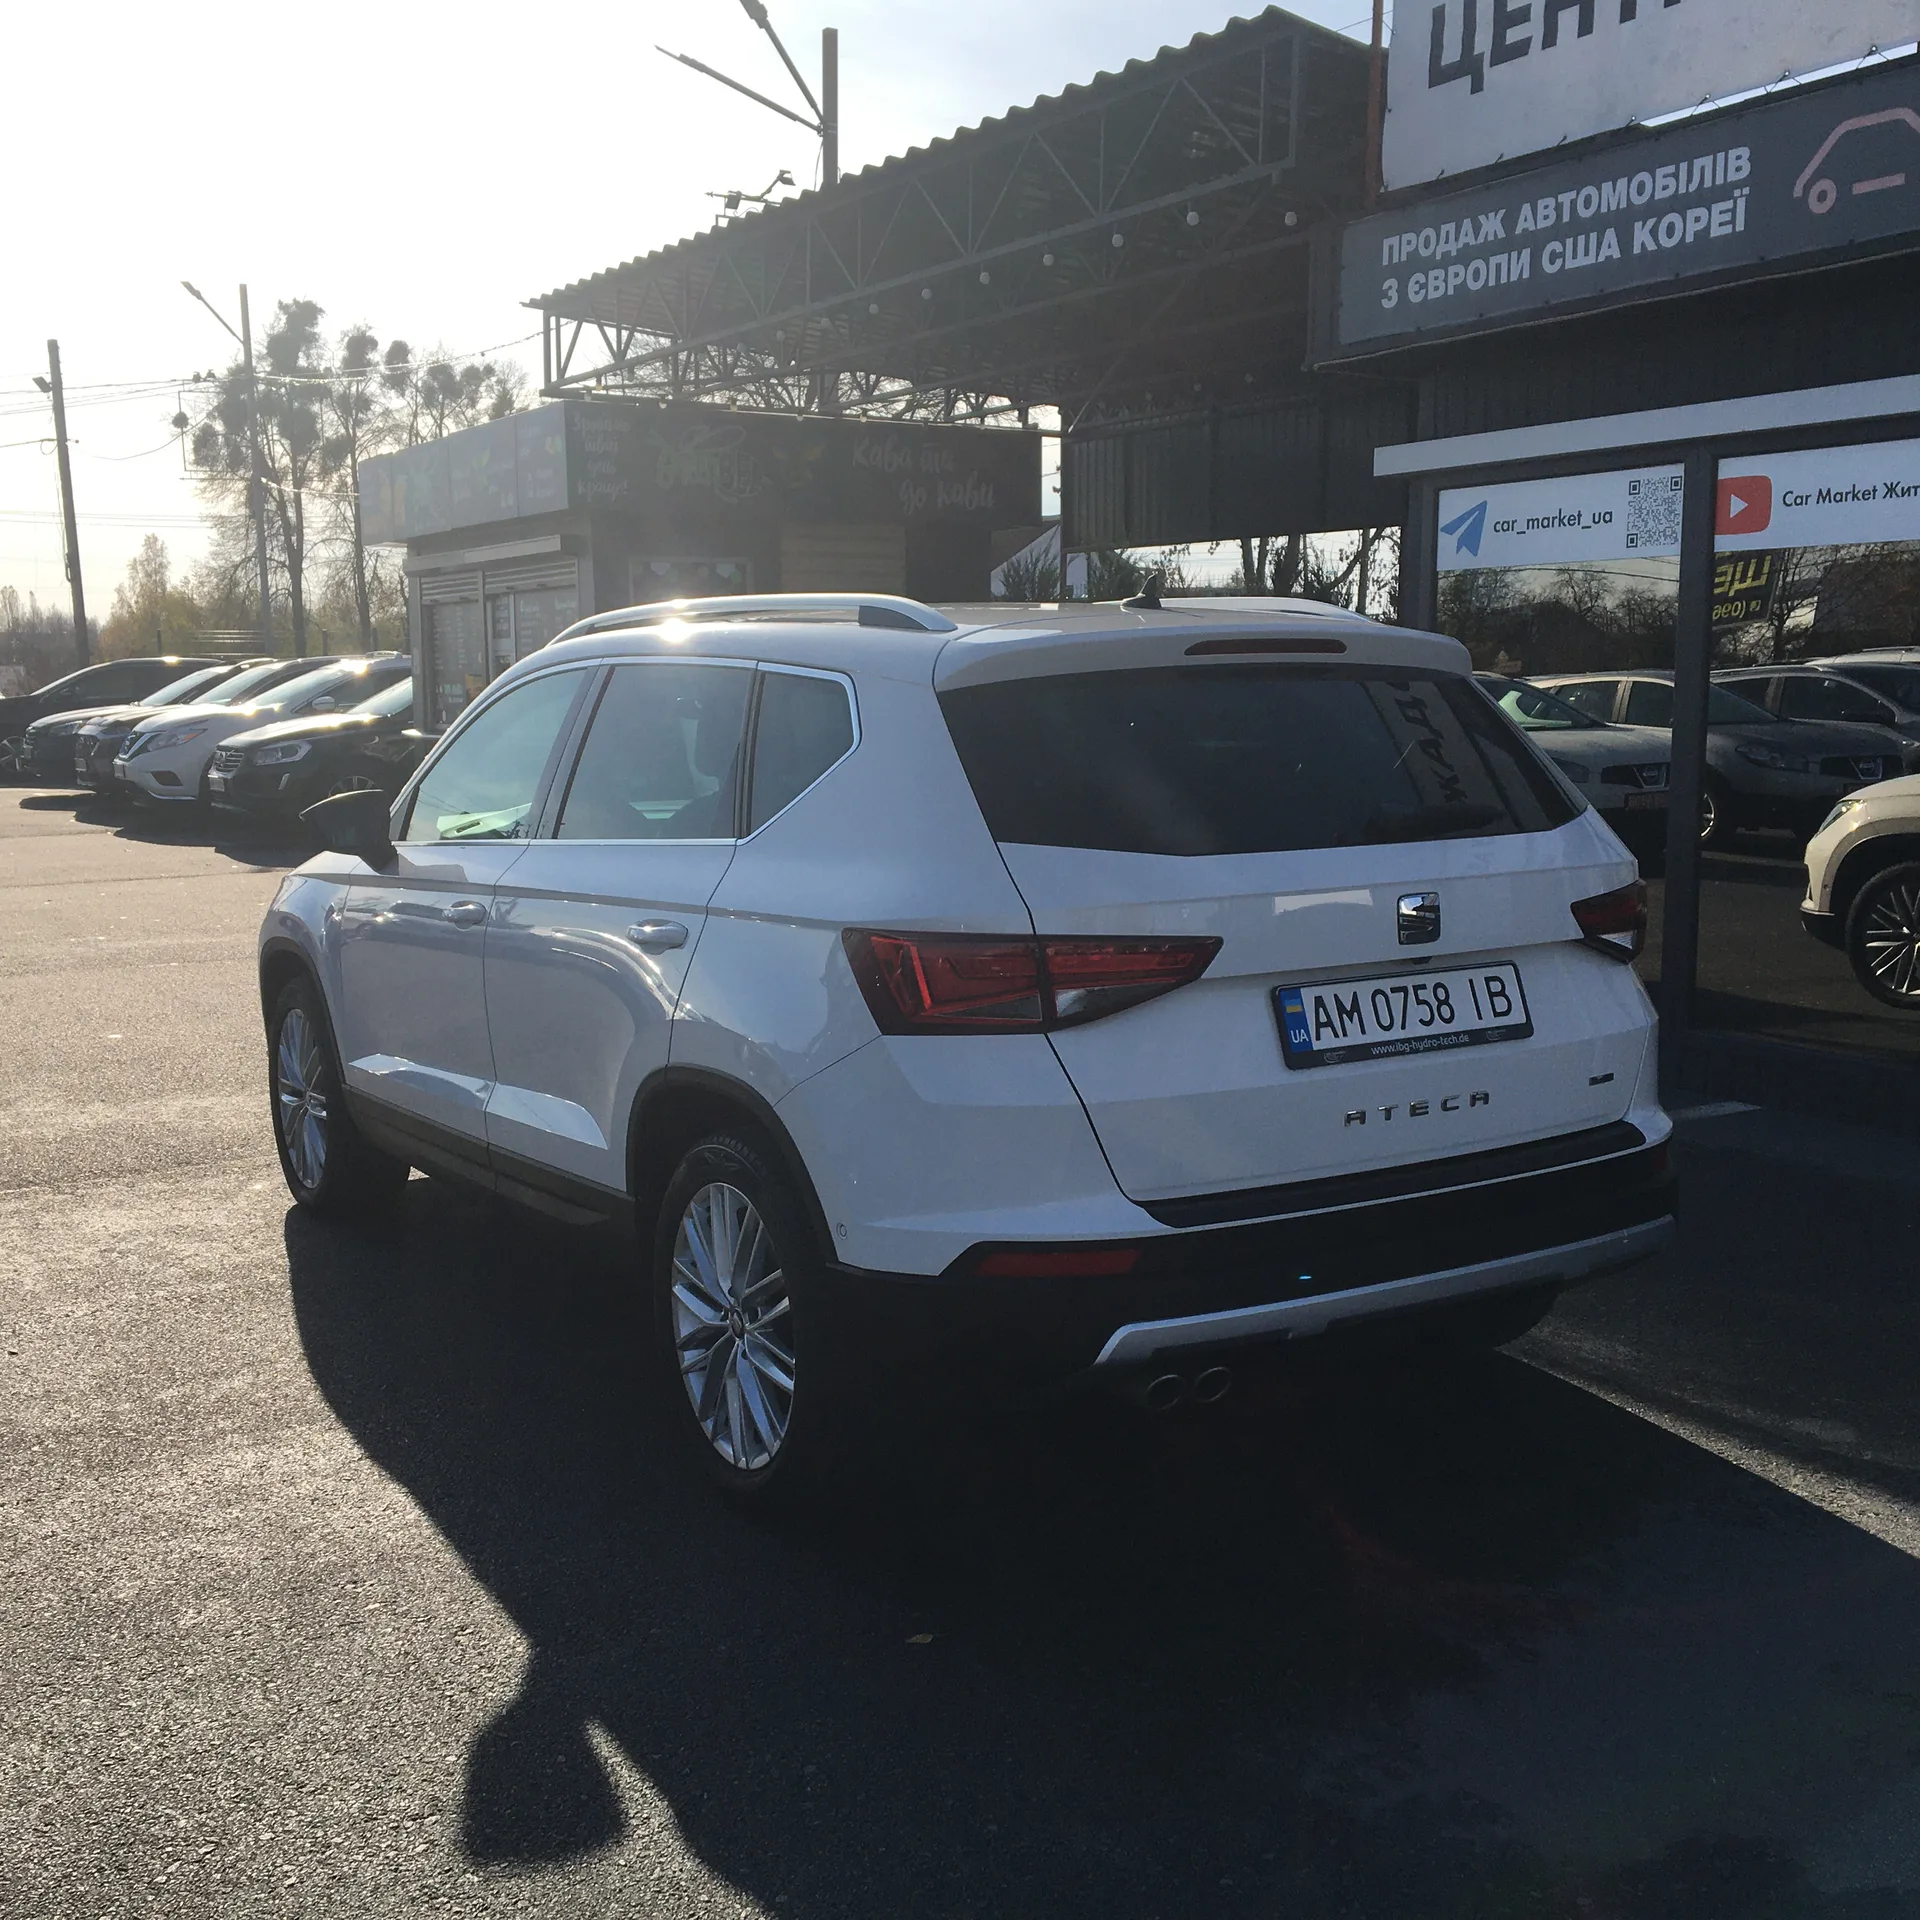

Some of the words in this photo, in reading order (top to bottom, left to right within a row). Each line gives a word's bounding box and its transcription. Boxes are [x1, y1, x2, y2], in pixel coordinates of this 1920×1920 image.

[1428, 0, 1682, 95] ЦЕН
[1382, 210, 1506, 267] ПРОДАЖ
[1515, 146, 1752, 236] АВТОМОБІЛІВ
[1381, 278, 1399, 309] З
[1407, 249, 1530, 304] ЄВРОПИ
[1541, 226, 1621, 274] США
[1633, 188, 1750, 254] КОРЕЇ
[1782, 490, 1812, 507] Car
[1816, 483, 1878, 505] Market
[1882, 481, 1920, 499] Жит
[1493, 508, 1613, 535] car_market_ua
[1314, 991, 1367, 1041] AM
[1372, 981, 1455, 1033] 0758
[1468, 975, 1513, 1021] IB
[1290, 1028, 1310, 1044] UA
[1371, 1033, 1470, 1055] www.ibg-hydro-tech.de
[1344, 1090, 1491, 1127] ATECA
